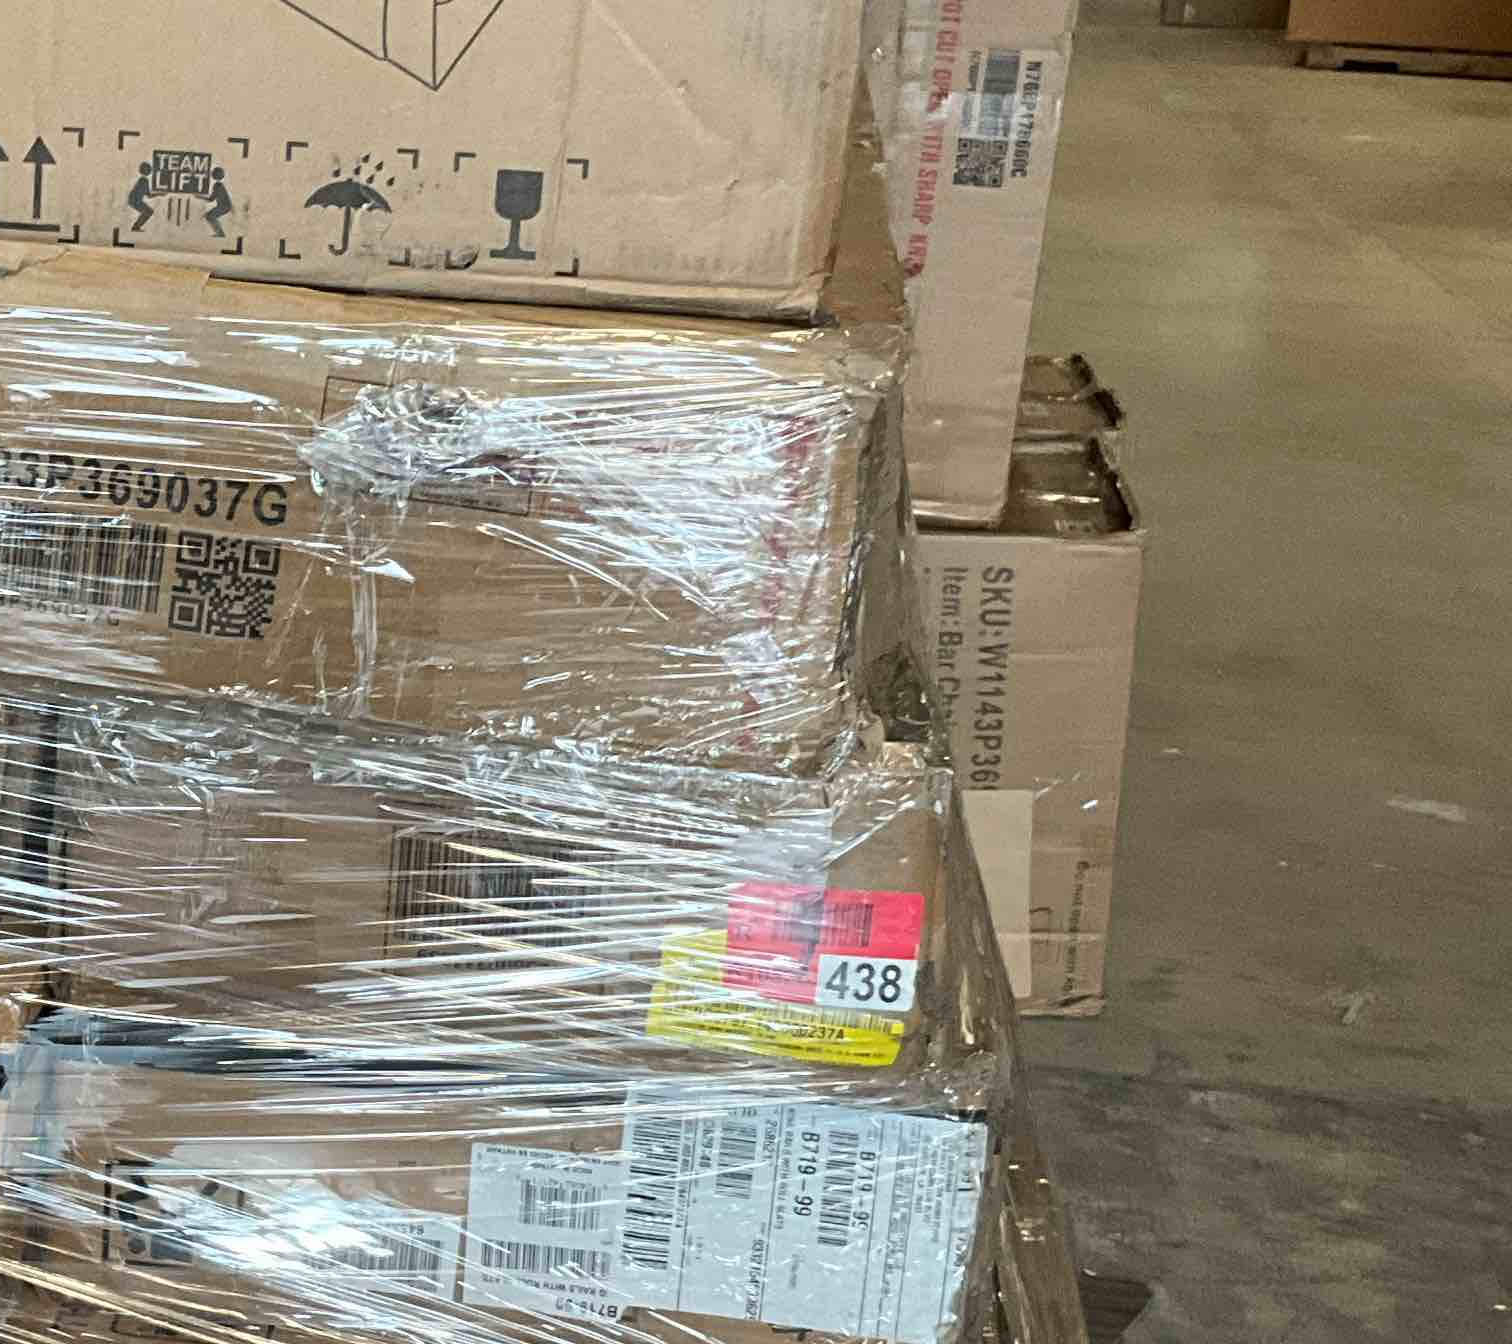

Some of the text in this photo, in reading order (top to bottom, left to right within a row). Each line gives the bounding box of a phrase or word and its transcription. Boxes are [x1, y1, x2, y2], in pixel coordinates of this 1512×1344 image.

[155, 153, 210, 173] TEAM
[155, 171, 209, 194] LIFT
[912, 169, 941, 225] SHARP
[941, 567, 969, 626] Item:
[937, 631, 964, 671] Bar
[824, 960, 903, 1005] 438
[793, 1131, 821, 1217] B719-99
